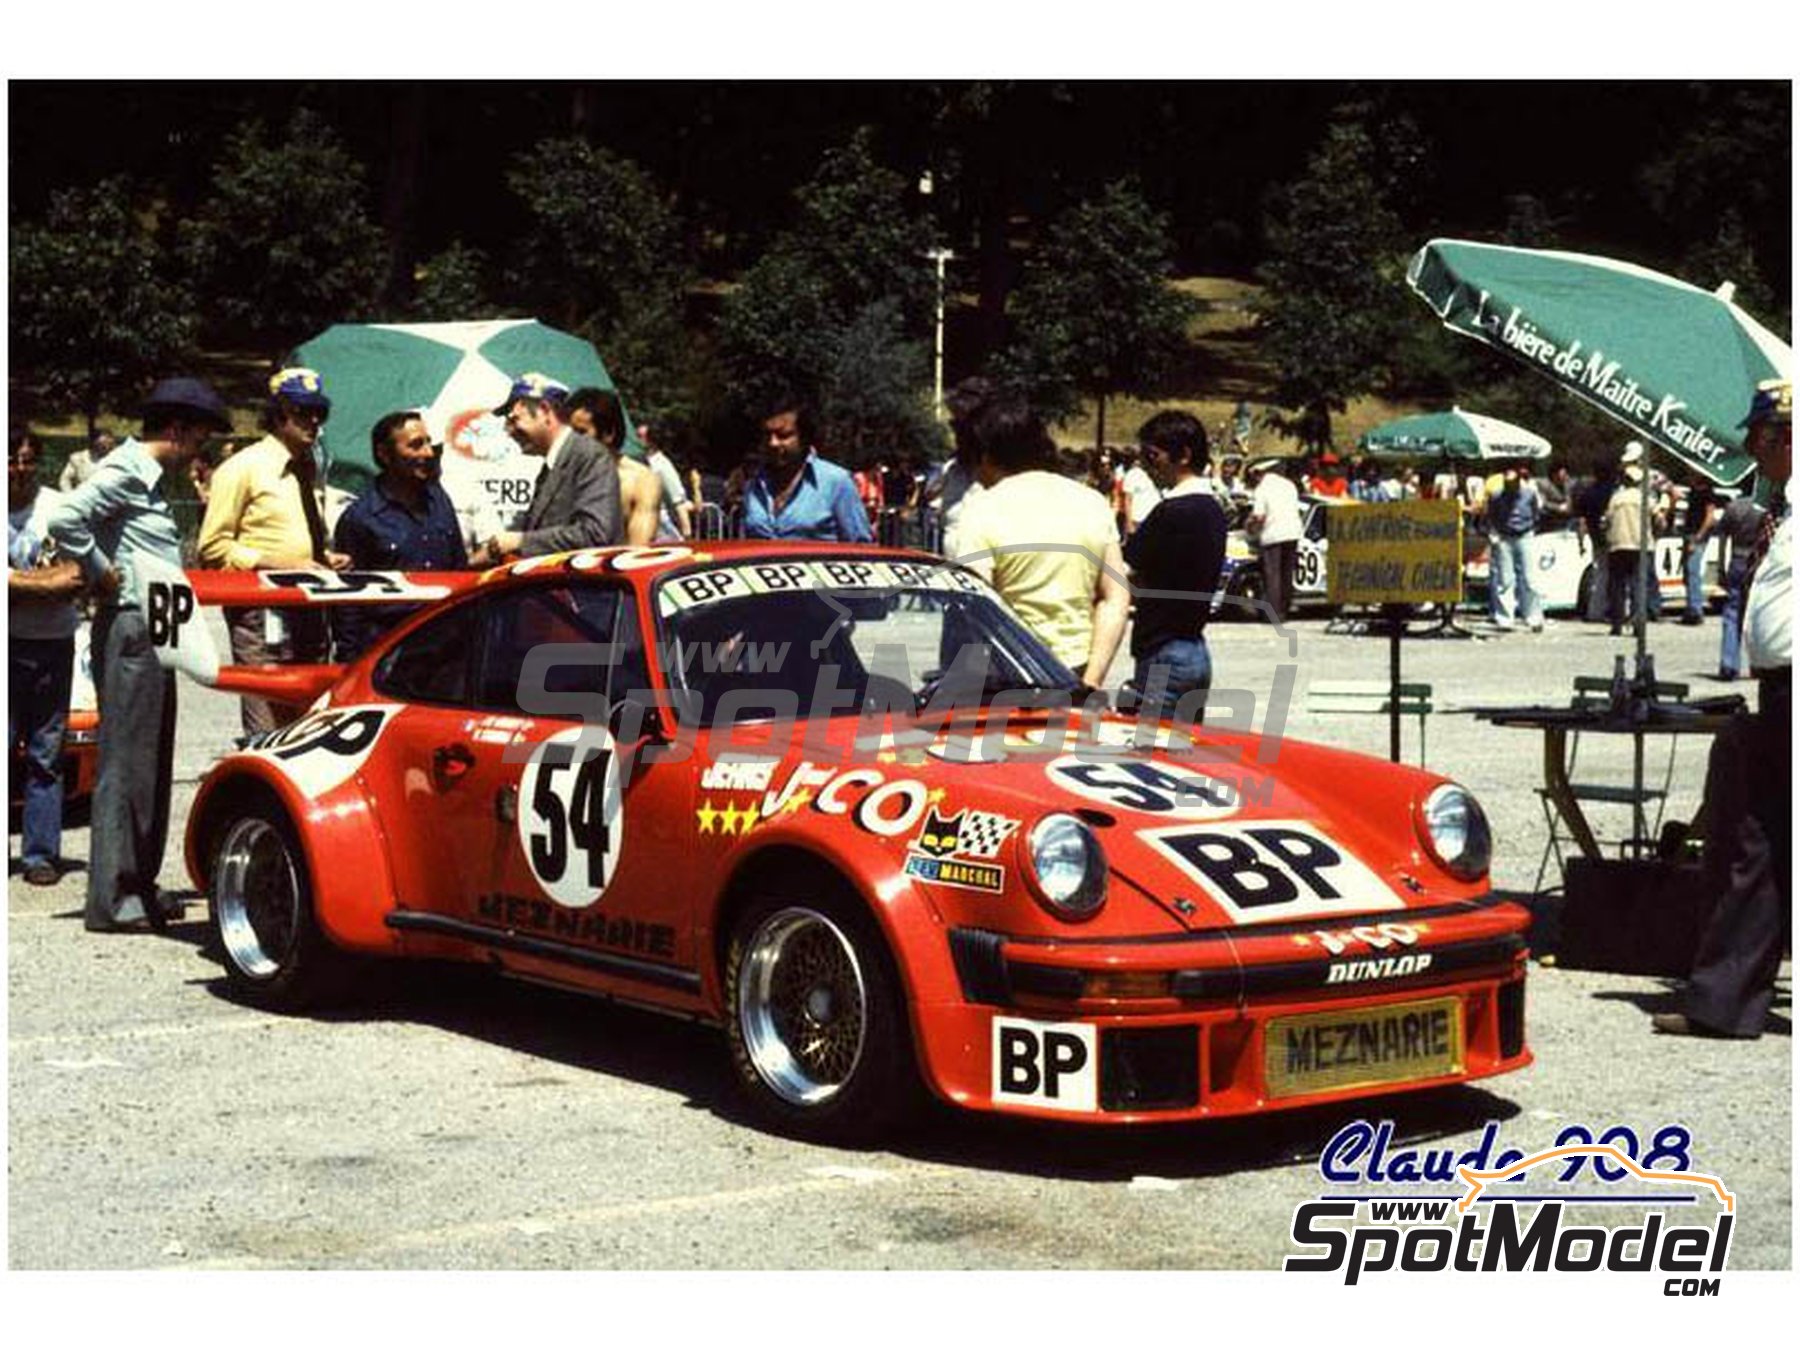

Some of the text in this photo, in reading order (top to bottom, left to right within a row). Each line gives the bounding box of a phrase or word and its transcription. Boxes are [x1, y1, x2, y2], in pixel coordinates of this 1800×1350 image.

[1553, 339, 1583, 378] de
[679, 573, 733, 603] BP
[755, 565, 806, 589] BP
[825, 564, 873, 586] BP
[890, 565, 933, 588] BP
[1296, 552, 1318, 586] 69
[148, 582, 194, 649] BP
[1054, 762, 1234, 802] 54
[530, 742, 612, 888] 54
[1158, 828, 1342, 909] BP
[1326, 954, 1432, 984] DUNLOP
[1000, 1026, 1087, 1099] BP
[1286, 1009, 1448, 1074] MEZNARIE
